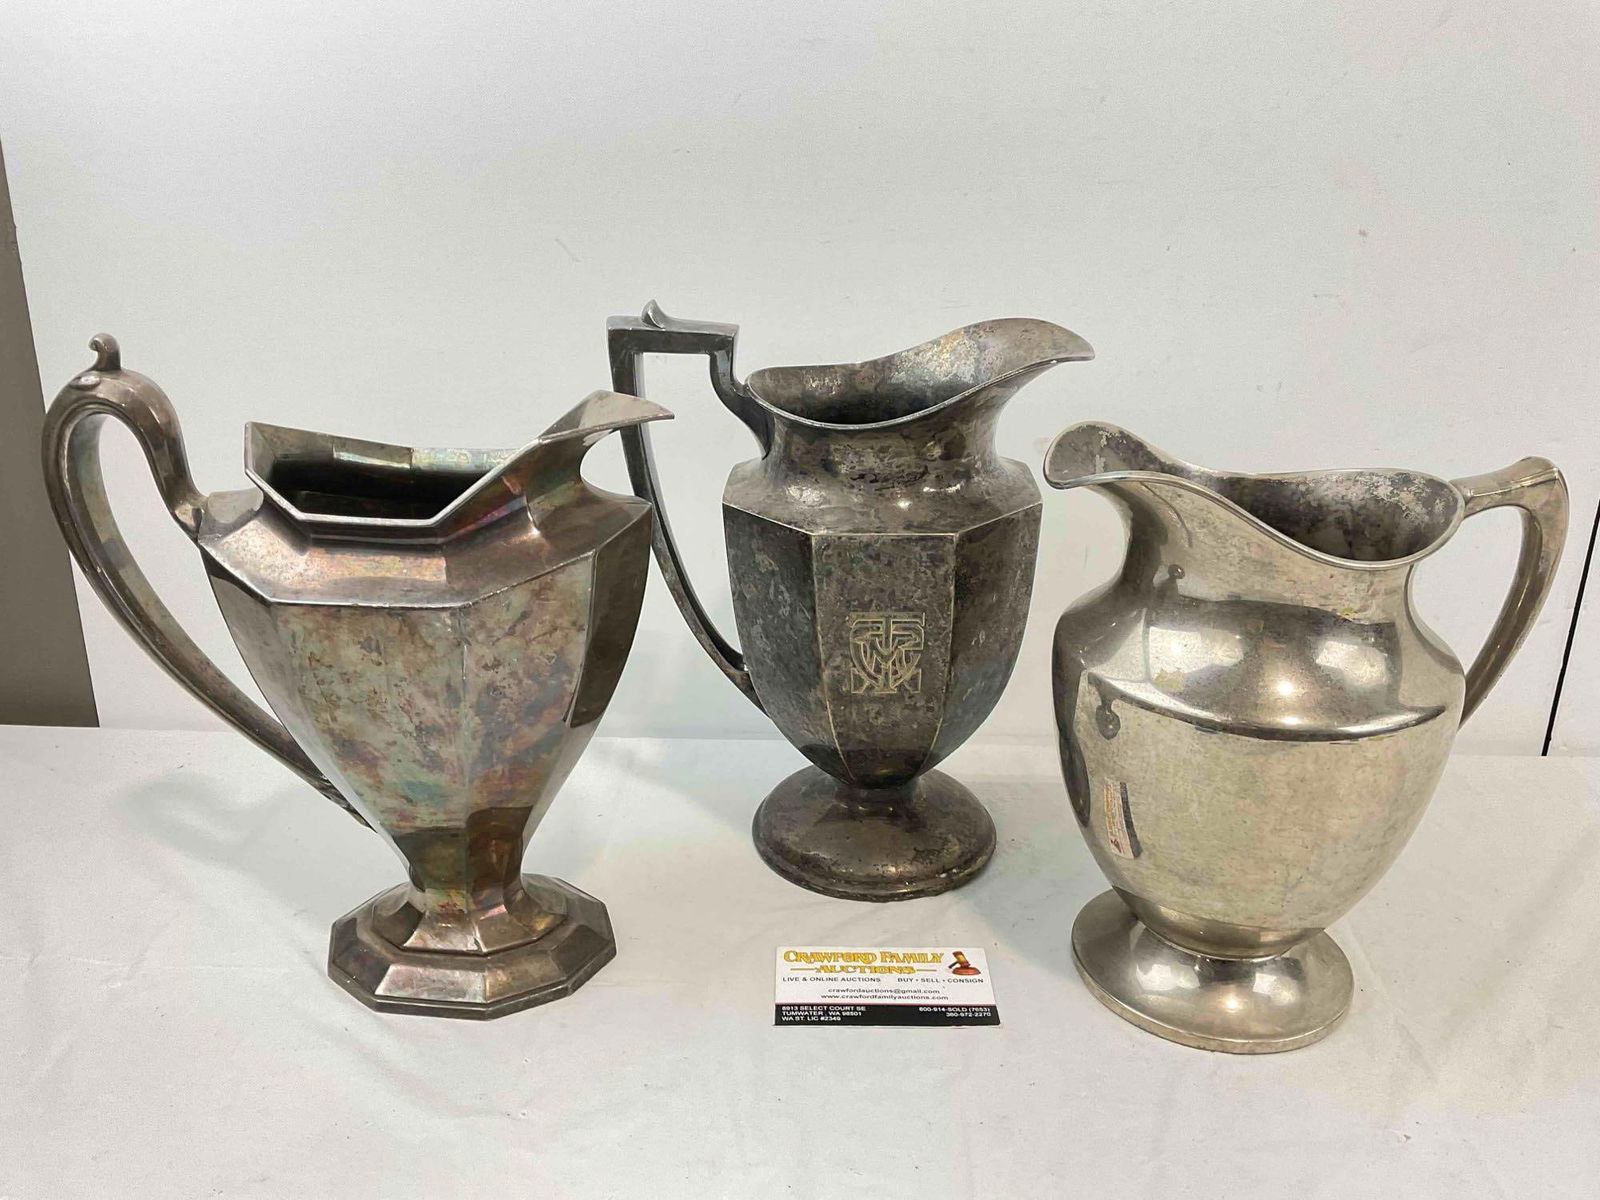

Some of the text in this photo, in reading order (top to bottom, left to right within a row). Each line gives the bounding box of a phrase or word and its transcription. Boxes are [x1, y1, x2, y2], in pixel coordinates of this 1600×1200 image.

[783, 950, 944, 964] CRAWFORD FAMILY
[815, 965, 916, 974] AUCTIONS
